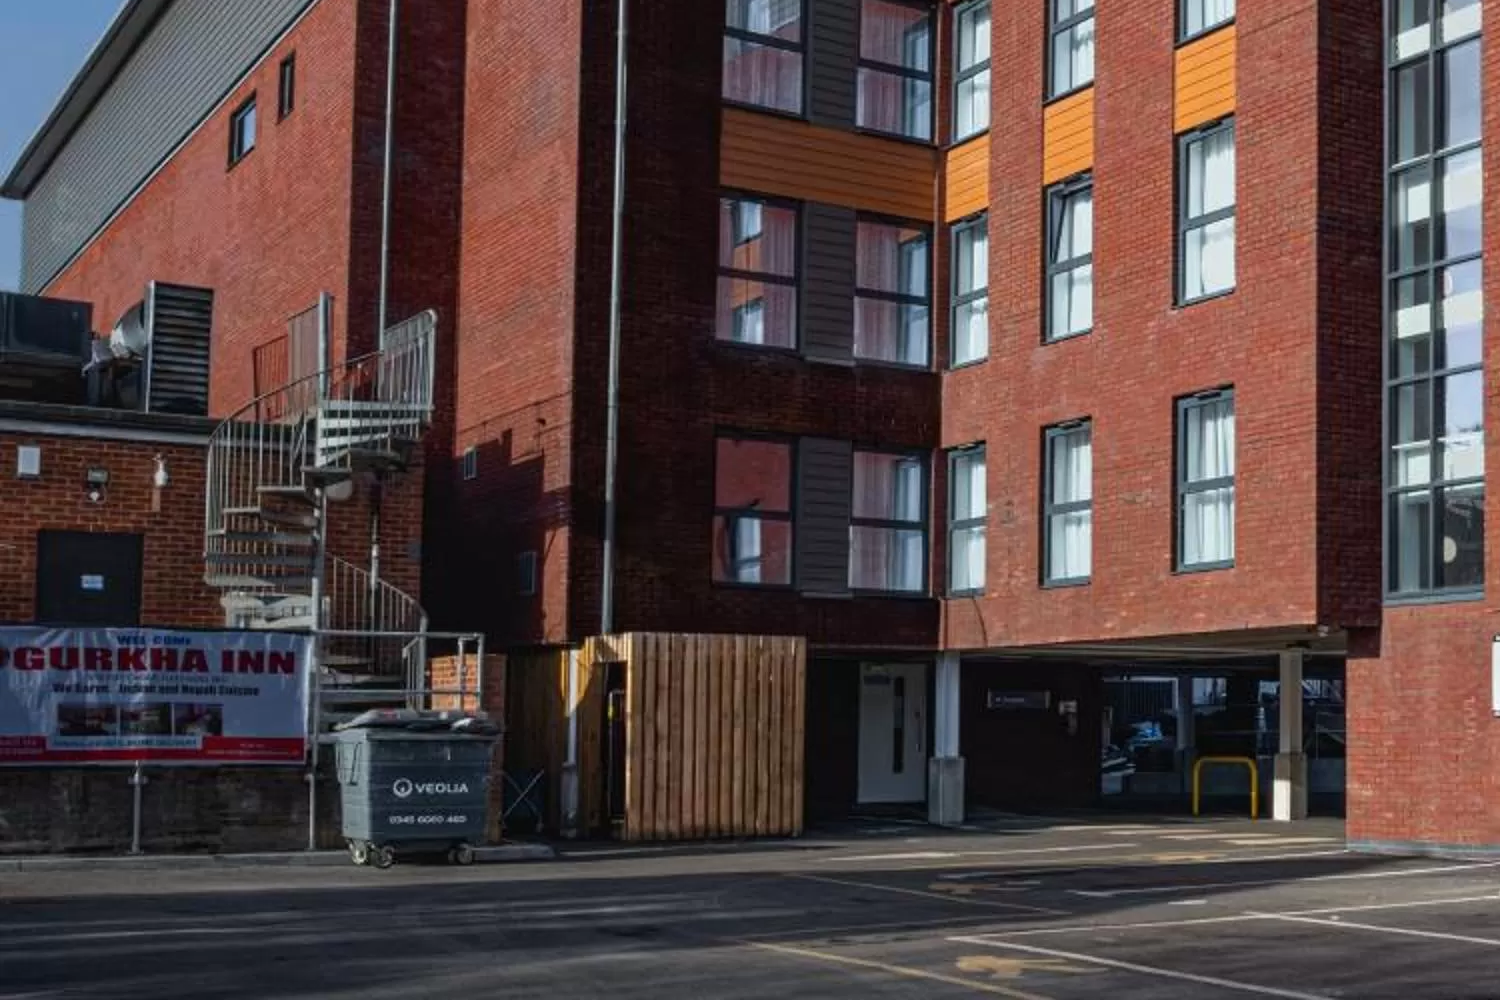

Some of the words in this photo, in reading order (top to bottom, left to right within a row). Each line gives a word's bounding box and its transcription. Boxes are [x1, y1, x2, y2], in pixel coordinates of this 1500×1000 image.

[14, 647, 209, 673] GURKHA
[222, 649, 295, 675] INN
[415, 783, 469, 793] VEOLIA
